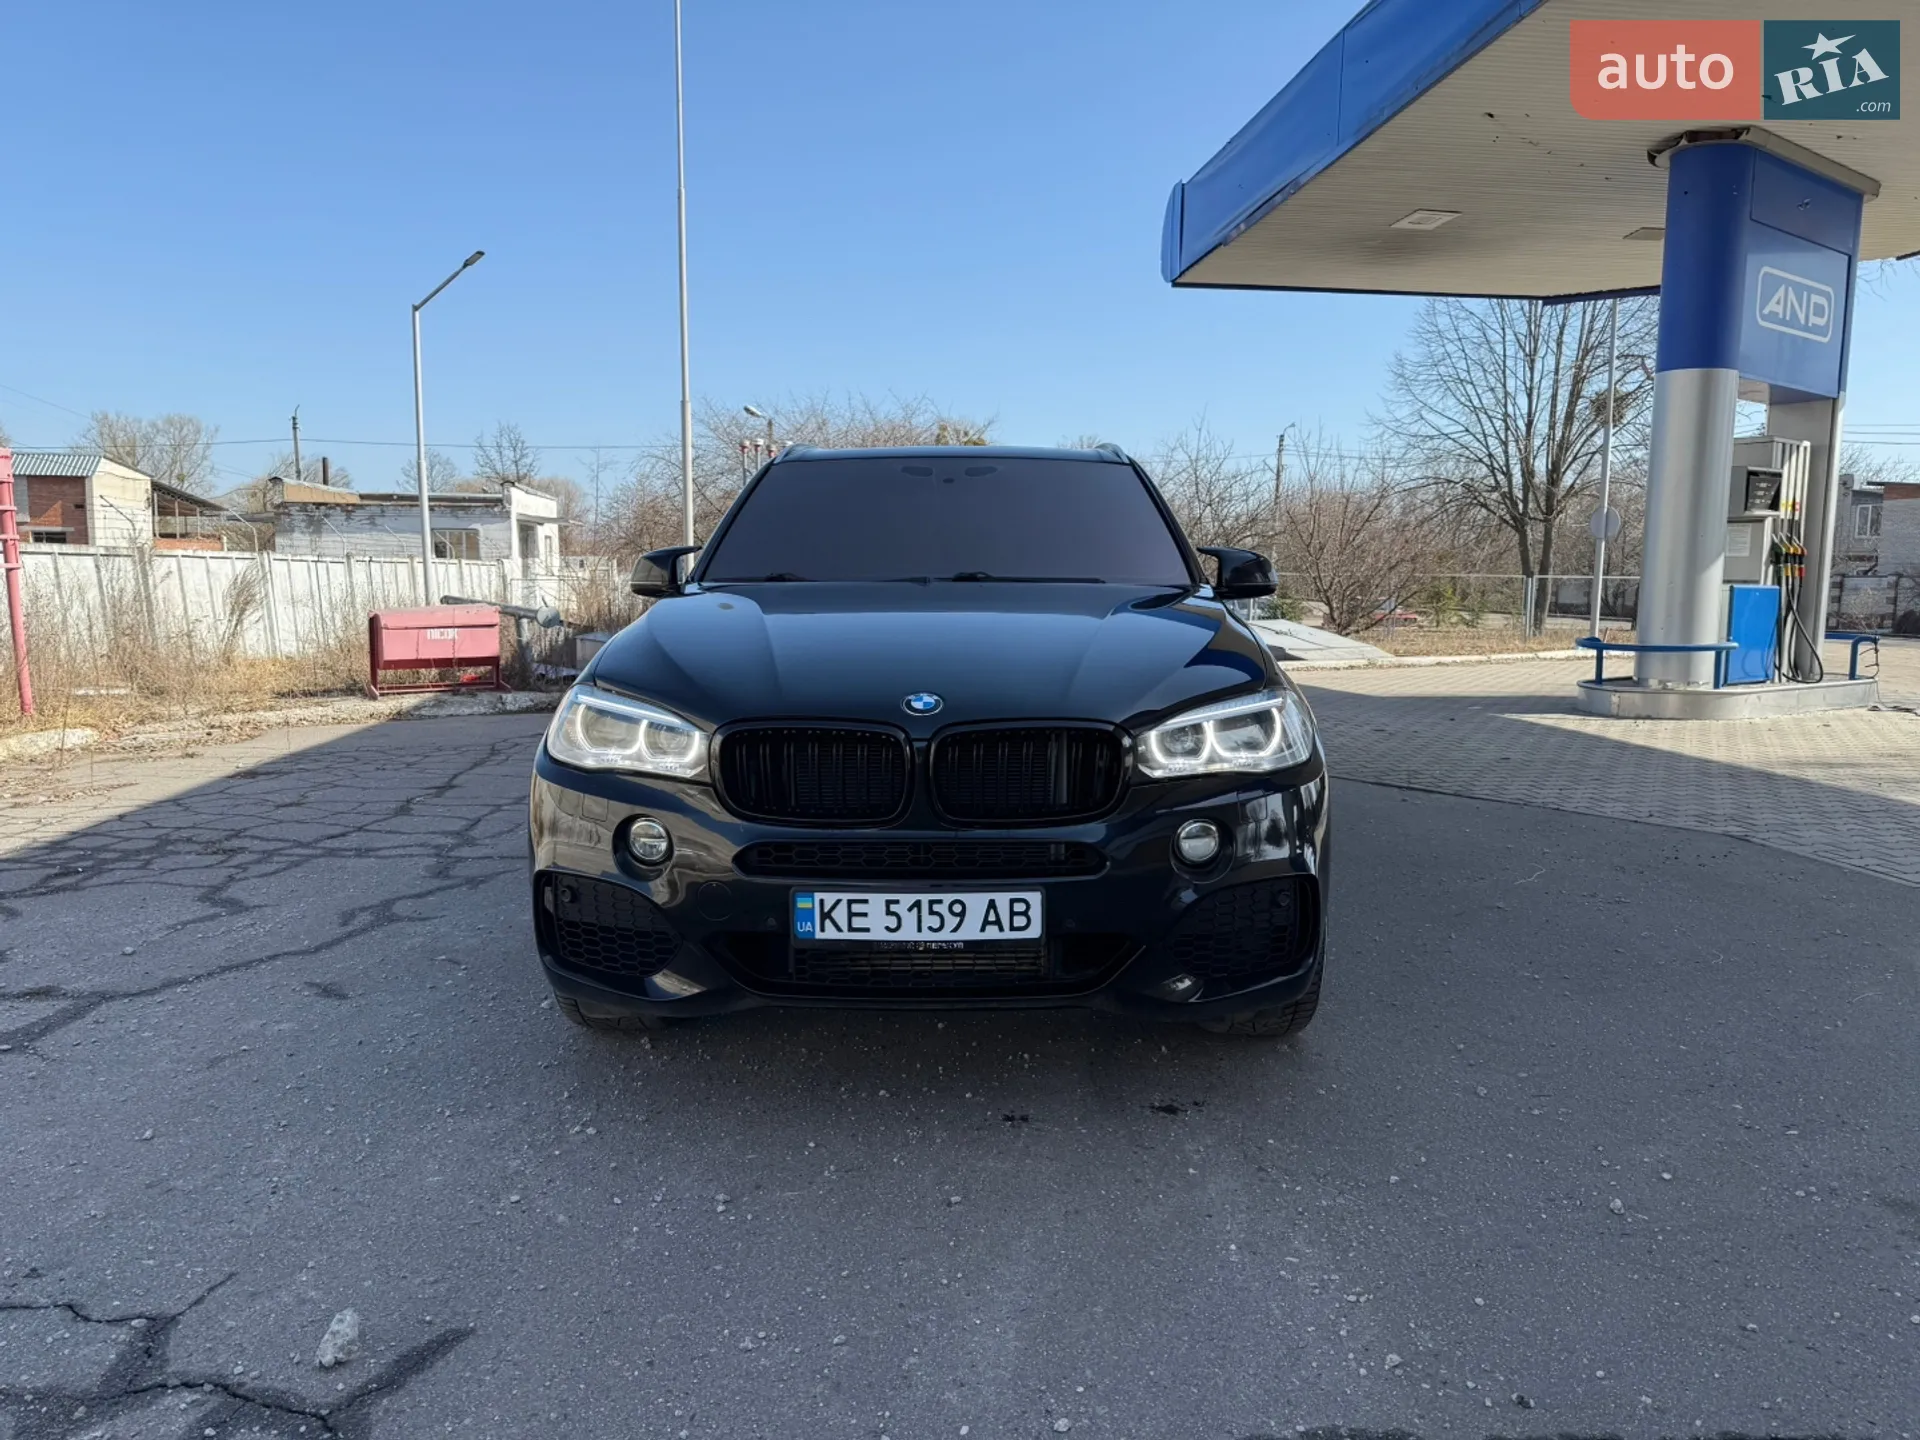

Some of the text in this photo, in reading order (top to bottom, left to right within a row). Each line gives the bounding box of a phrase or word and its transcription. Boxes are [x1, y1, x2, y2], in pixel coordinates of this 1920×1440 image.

[797, 921, 813, 933] UA
[819, 897, 1032, 933] KE 5159 AB
